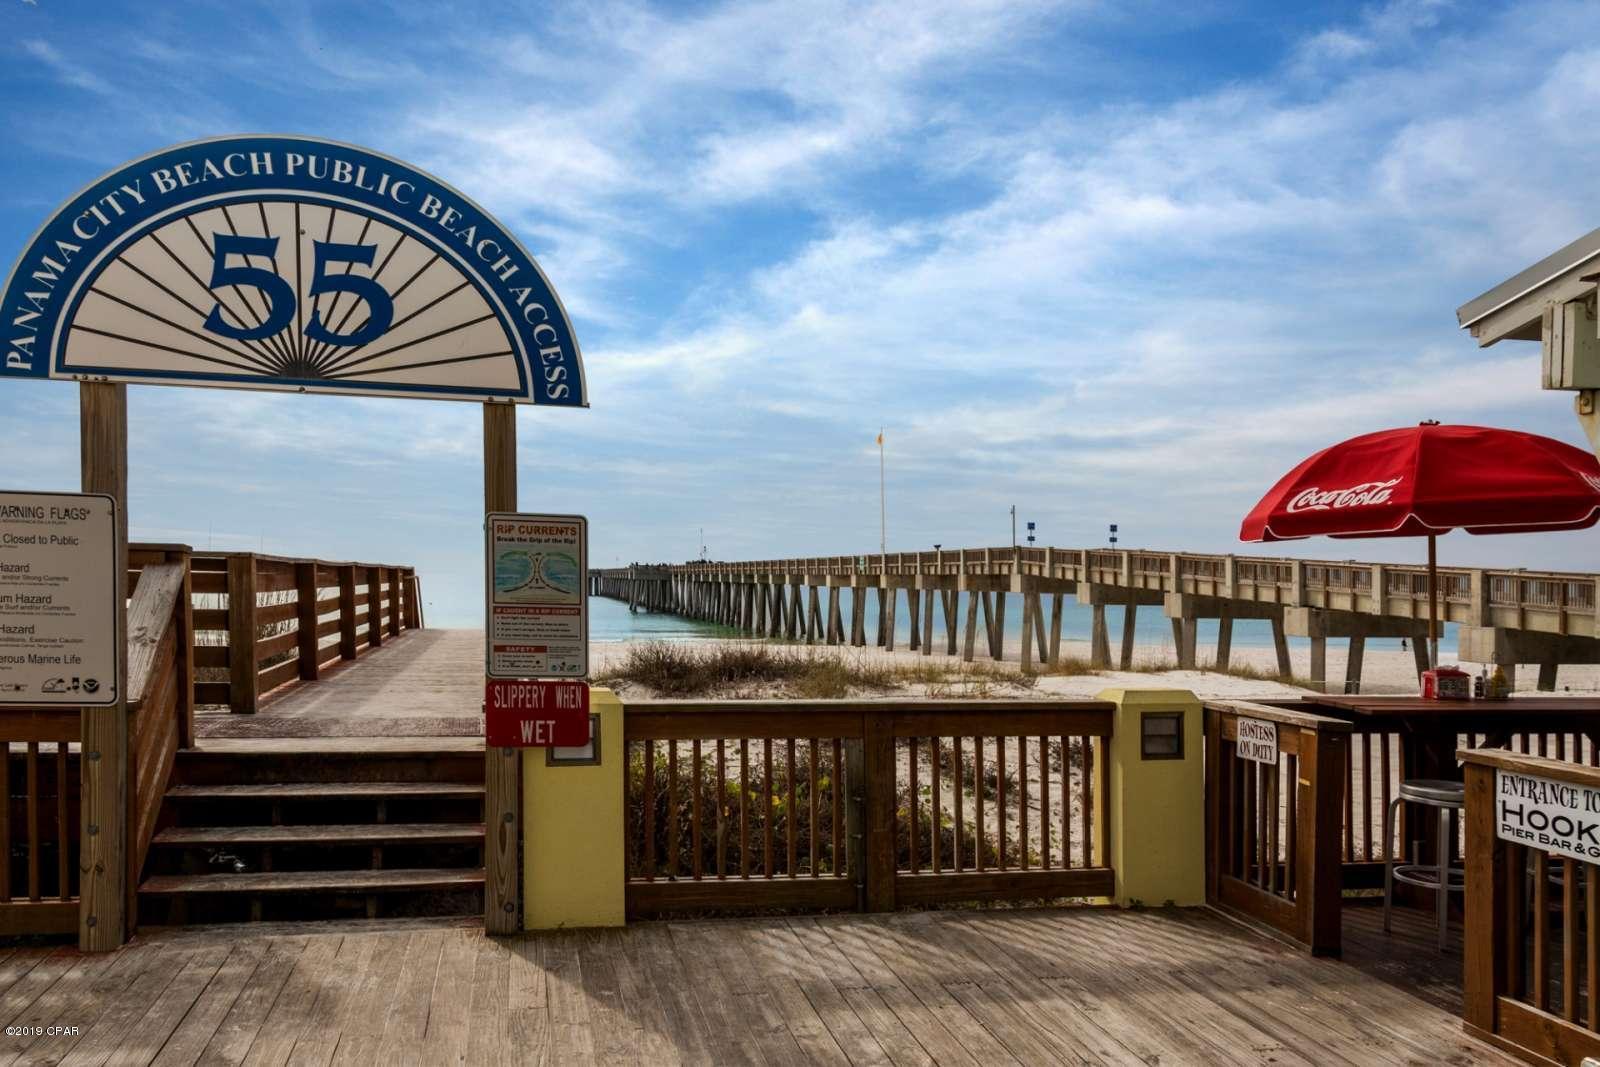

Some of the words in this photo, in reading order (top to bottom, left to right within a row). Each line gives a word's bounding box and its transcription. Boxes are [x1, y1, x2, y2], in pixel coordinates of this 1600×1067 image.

[6, 239, 82, 370] PANAMA
[73, 180, 146, 239] CITY
[151, 152, 274, 194] BEACH
[286, 153, 415, 205] PUBLIC
[419, 194, 519, 282] BEACH
[509, 285, 569, 400] ACCESS
[203, 232, 395, 347] 55
[0, 506, 44, 519] ARNING
[3, 533, 36, 544] Closed
[38, 535, 47, 545] to
[50, 535, 79, 546] Public
[496, 524, 515, 534] RIP
[518, 525, 577, 536] CURRENTS
[15, 593, 52, 604] Hazard
[28, 654, 61, 664] Marine
[64, 654, 81, 664] Life
[494, 685, 546, 708] SLIPPERY
[555, 686, 582, 709] WHEN
[520, 720, 556, 743] WET
[1240, 721, 1274, 742] HOSTESS
[1240, 740, 1250, 755] ON
[1501, 774, 1578, 809] ENTRANCE
[1502, 800, 1600, 845] HOOK
[1501, 824, 1535, 841] PIER
